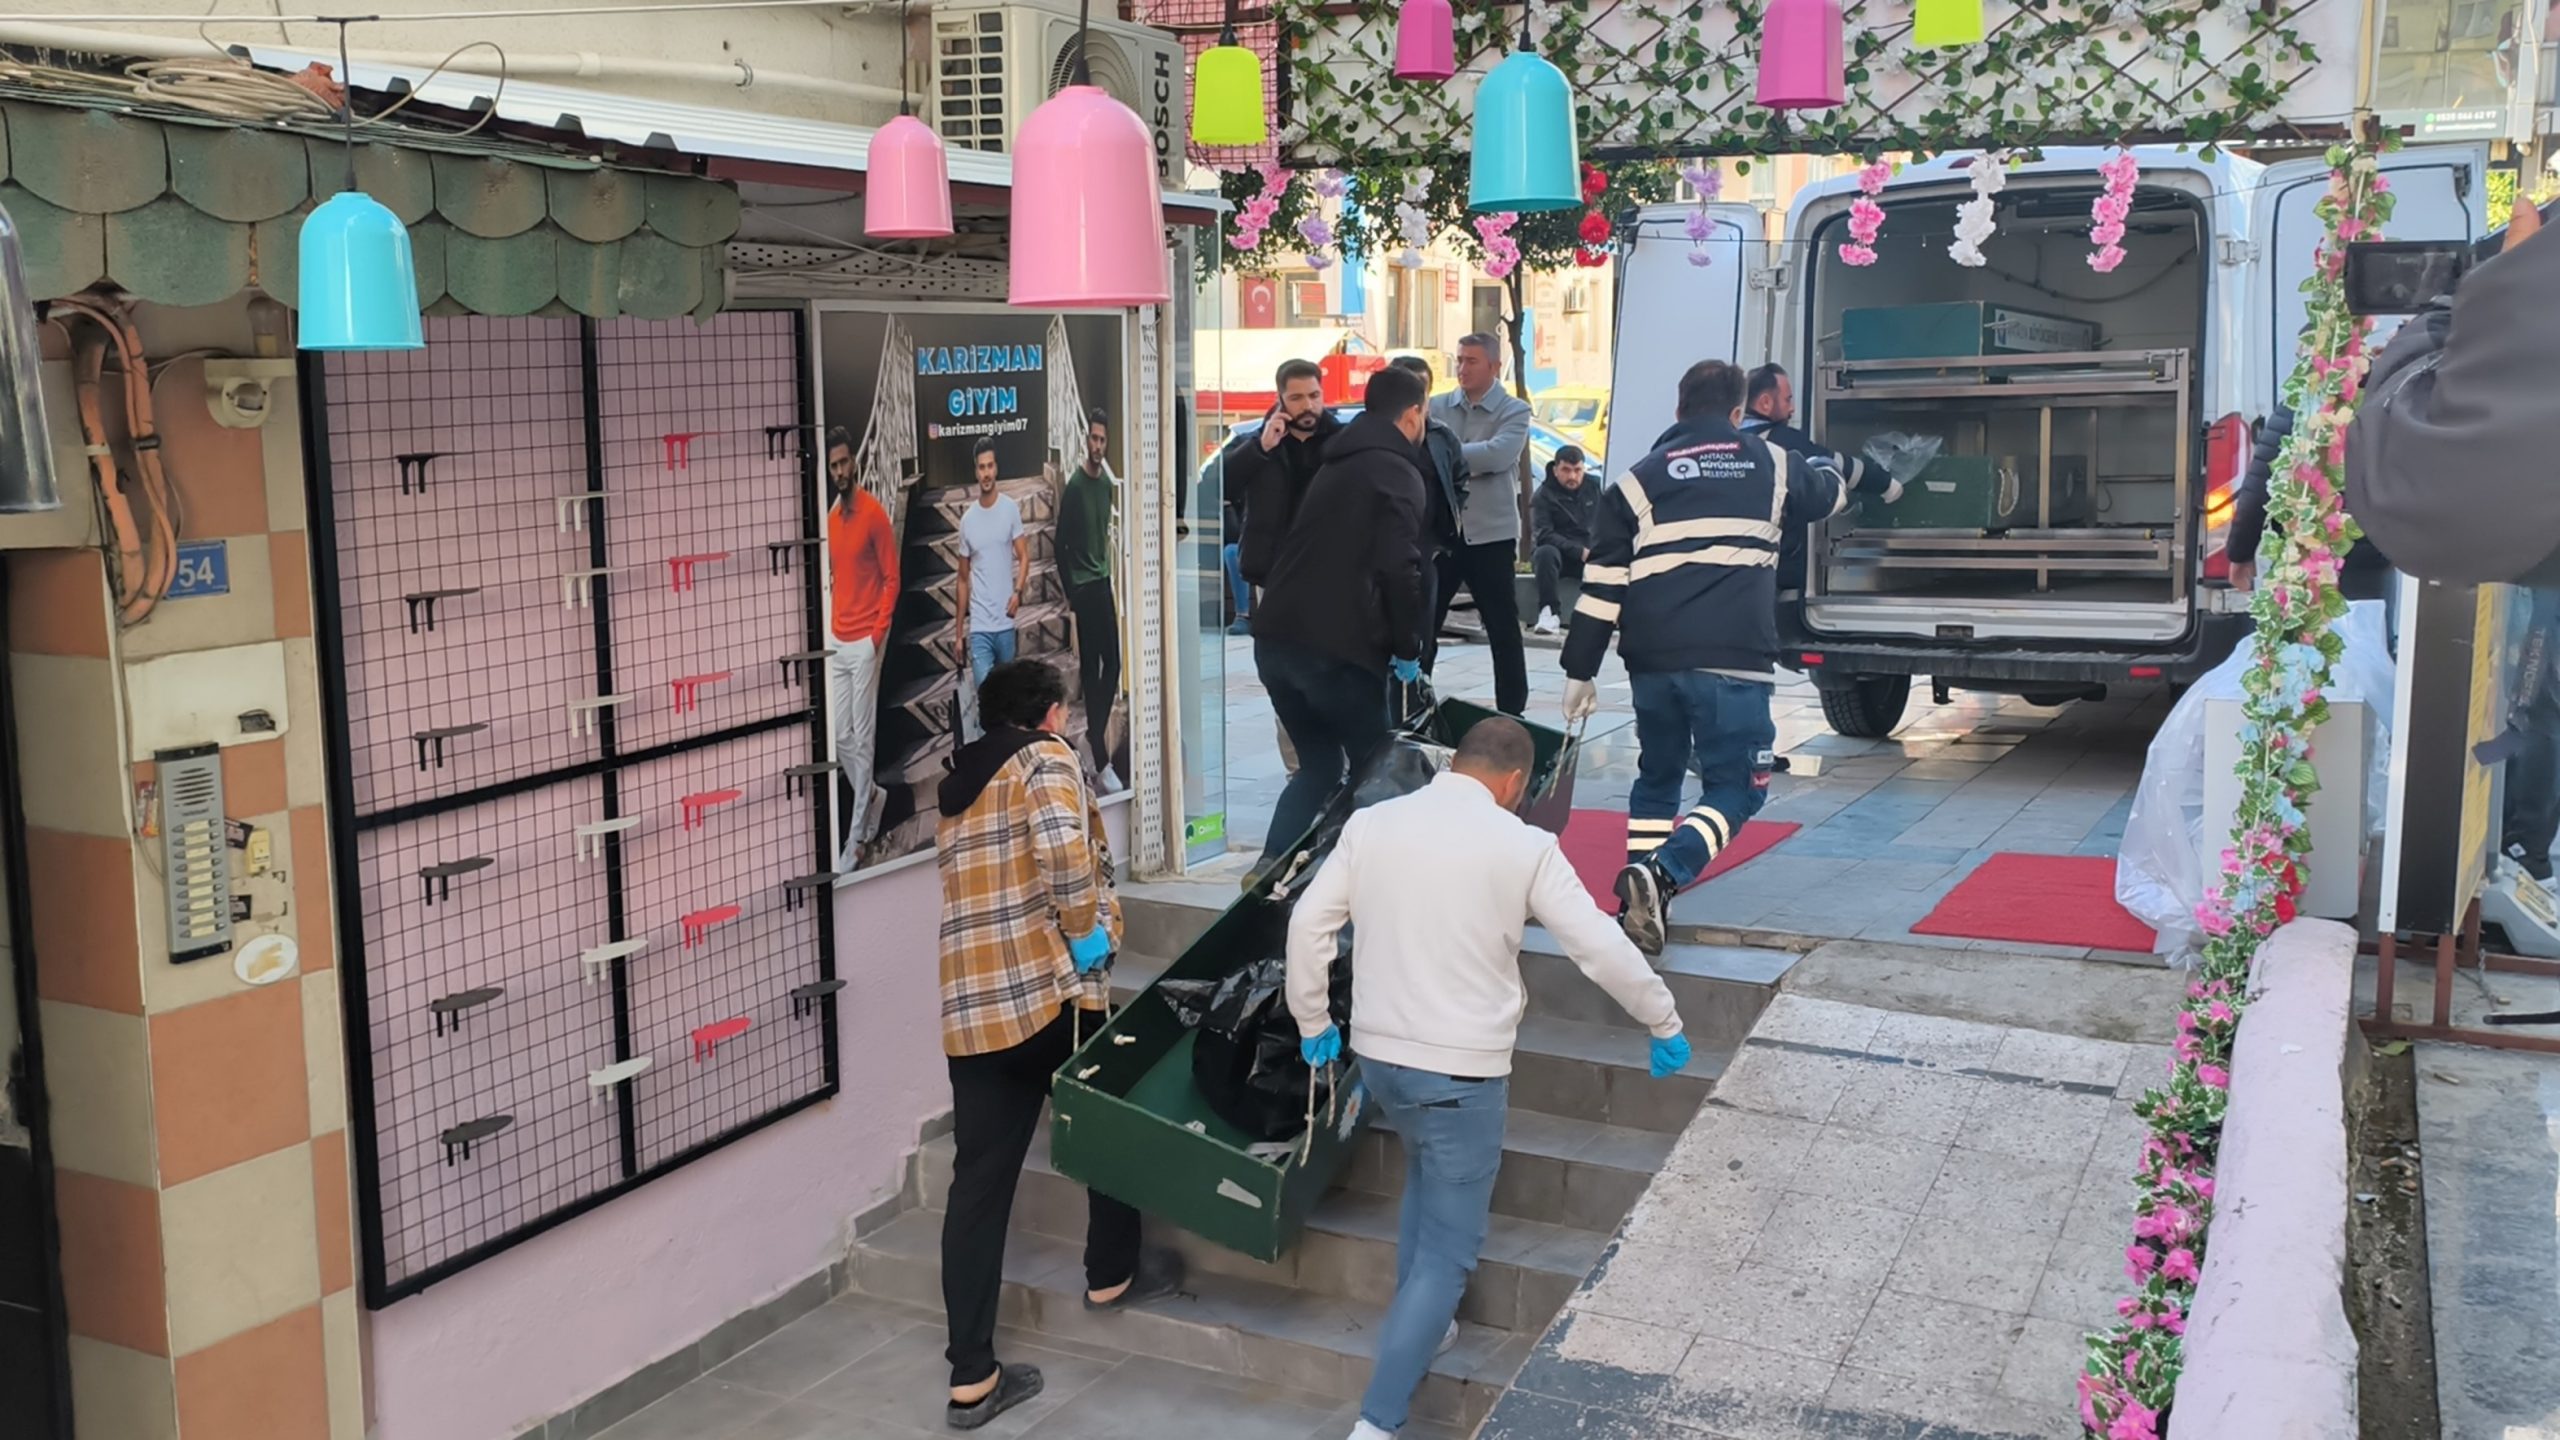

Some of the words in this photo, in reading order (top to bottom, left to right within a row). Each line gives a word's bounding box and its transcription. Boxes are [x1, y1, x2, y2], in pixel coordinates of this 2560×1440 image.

[1154, 51, 1170, 177] BOSCH
[938, 418, 1028, 437] karizmangiyim07
[1699, 452, 1735, 461] ANTALYA
[179, 556, 215, 588] 54
